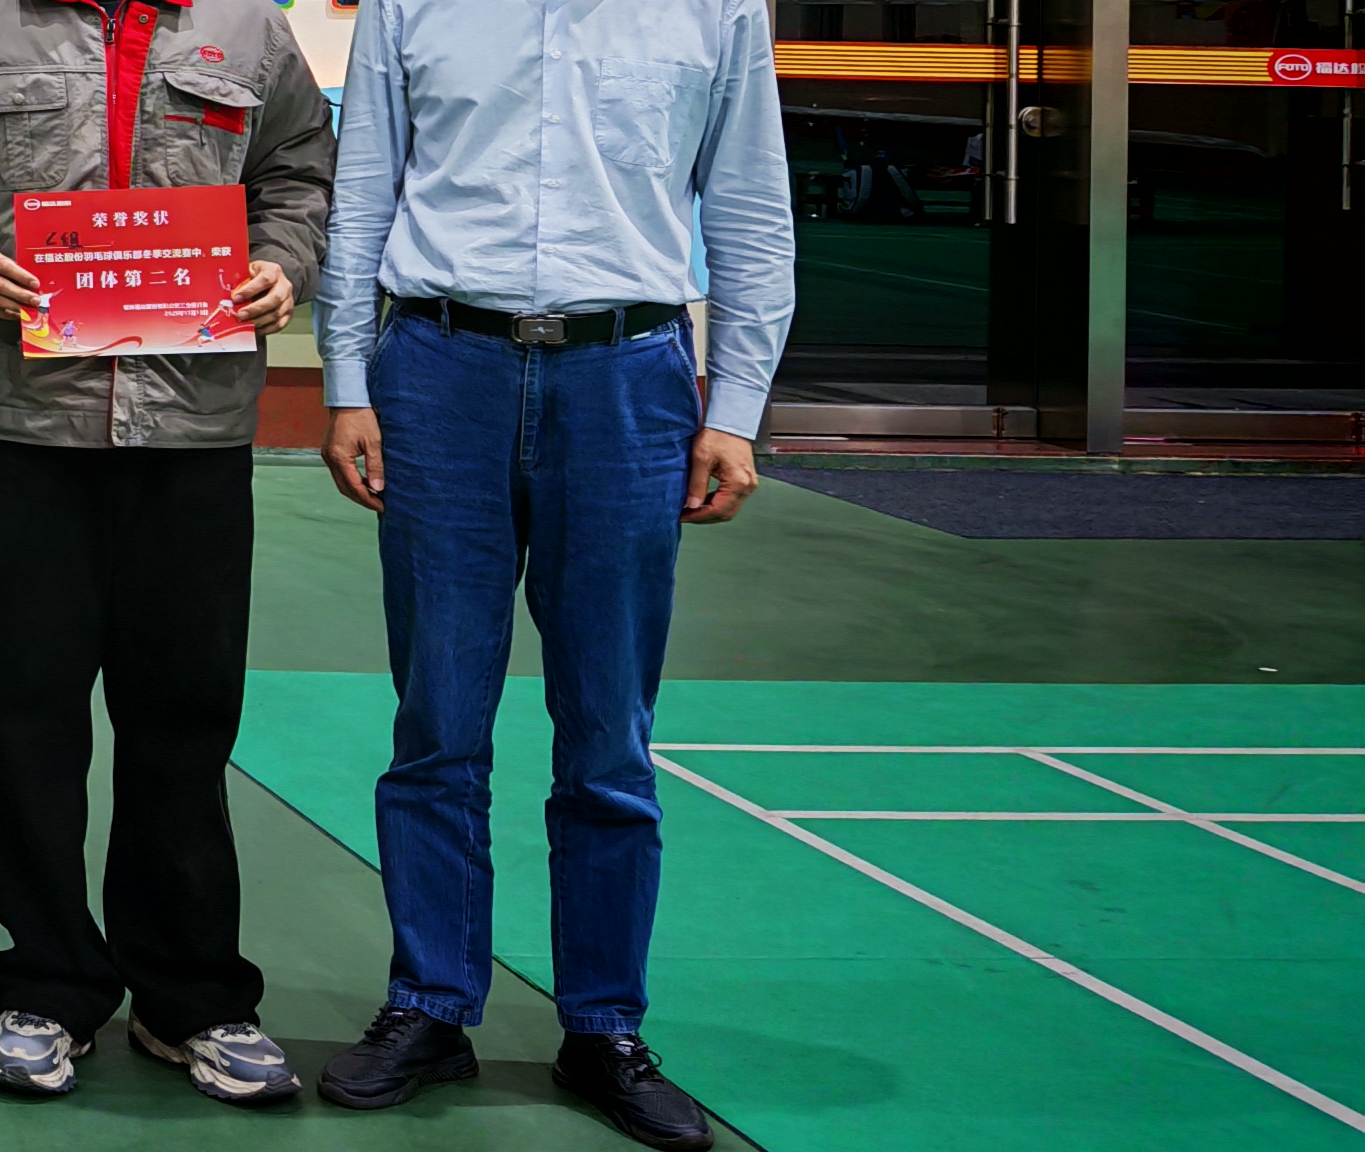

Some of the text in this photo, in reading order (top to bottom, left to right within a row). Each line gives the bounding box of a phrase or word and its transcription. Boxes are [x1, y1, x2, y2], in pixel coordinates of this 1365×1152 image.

[91, 210, 169, 228] 荣誉奖状
[75, 268, 191, 290] 团体第二名
